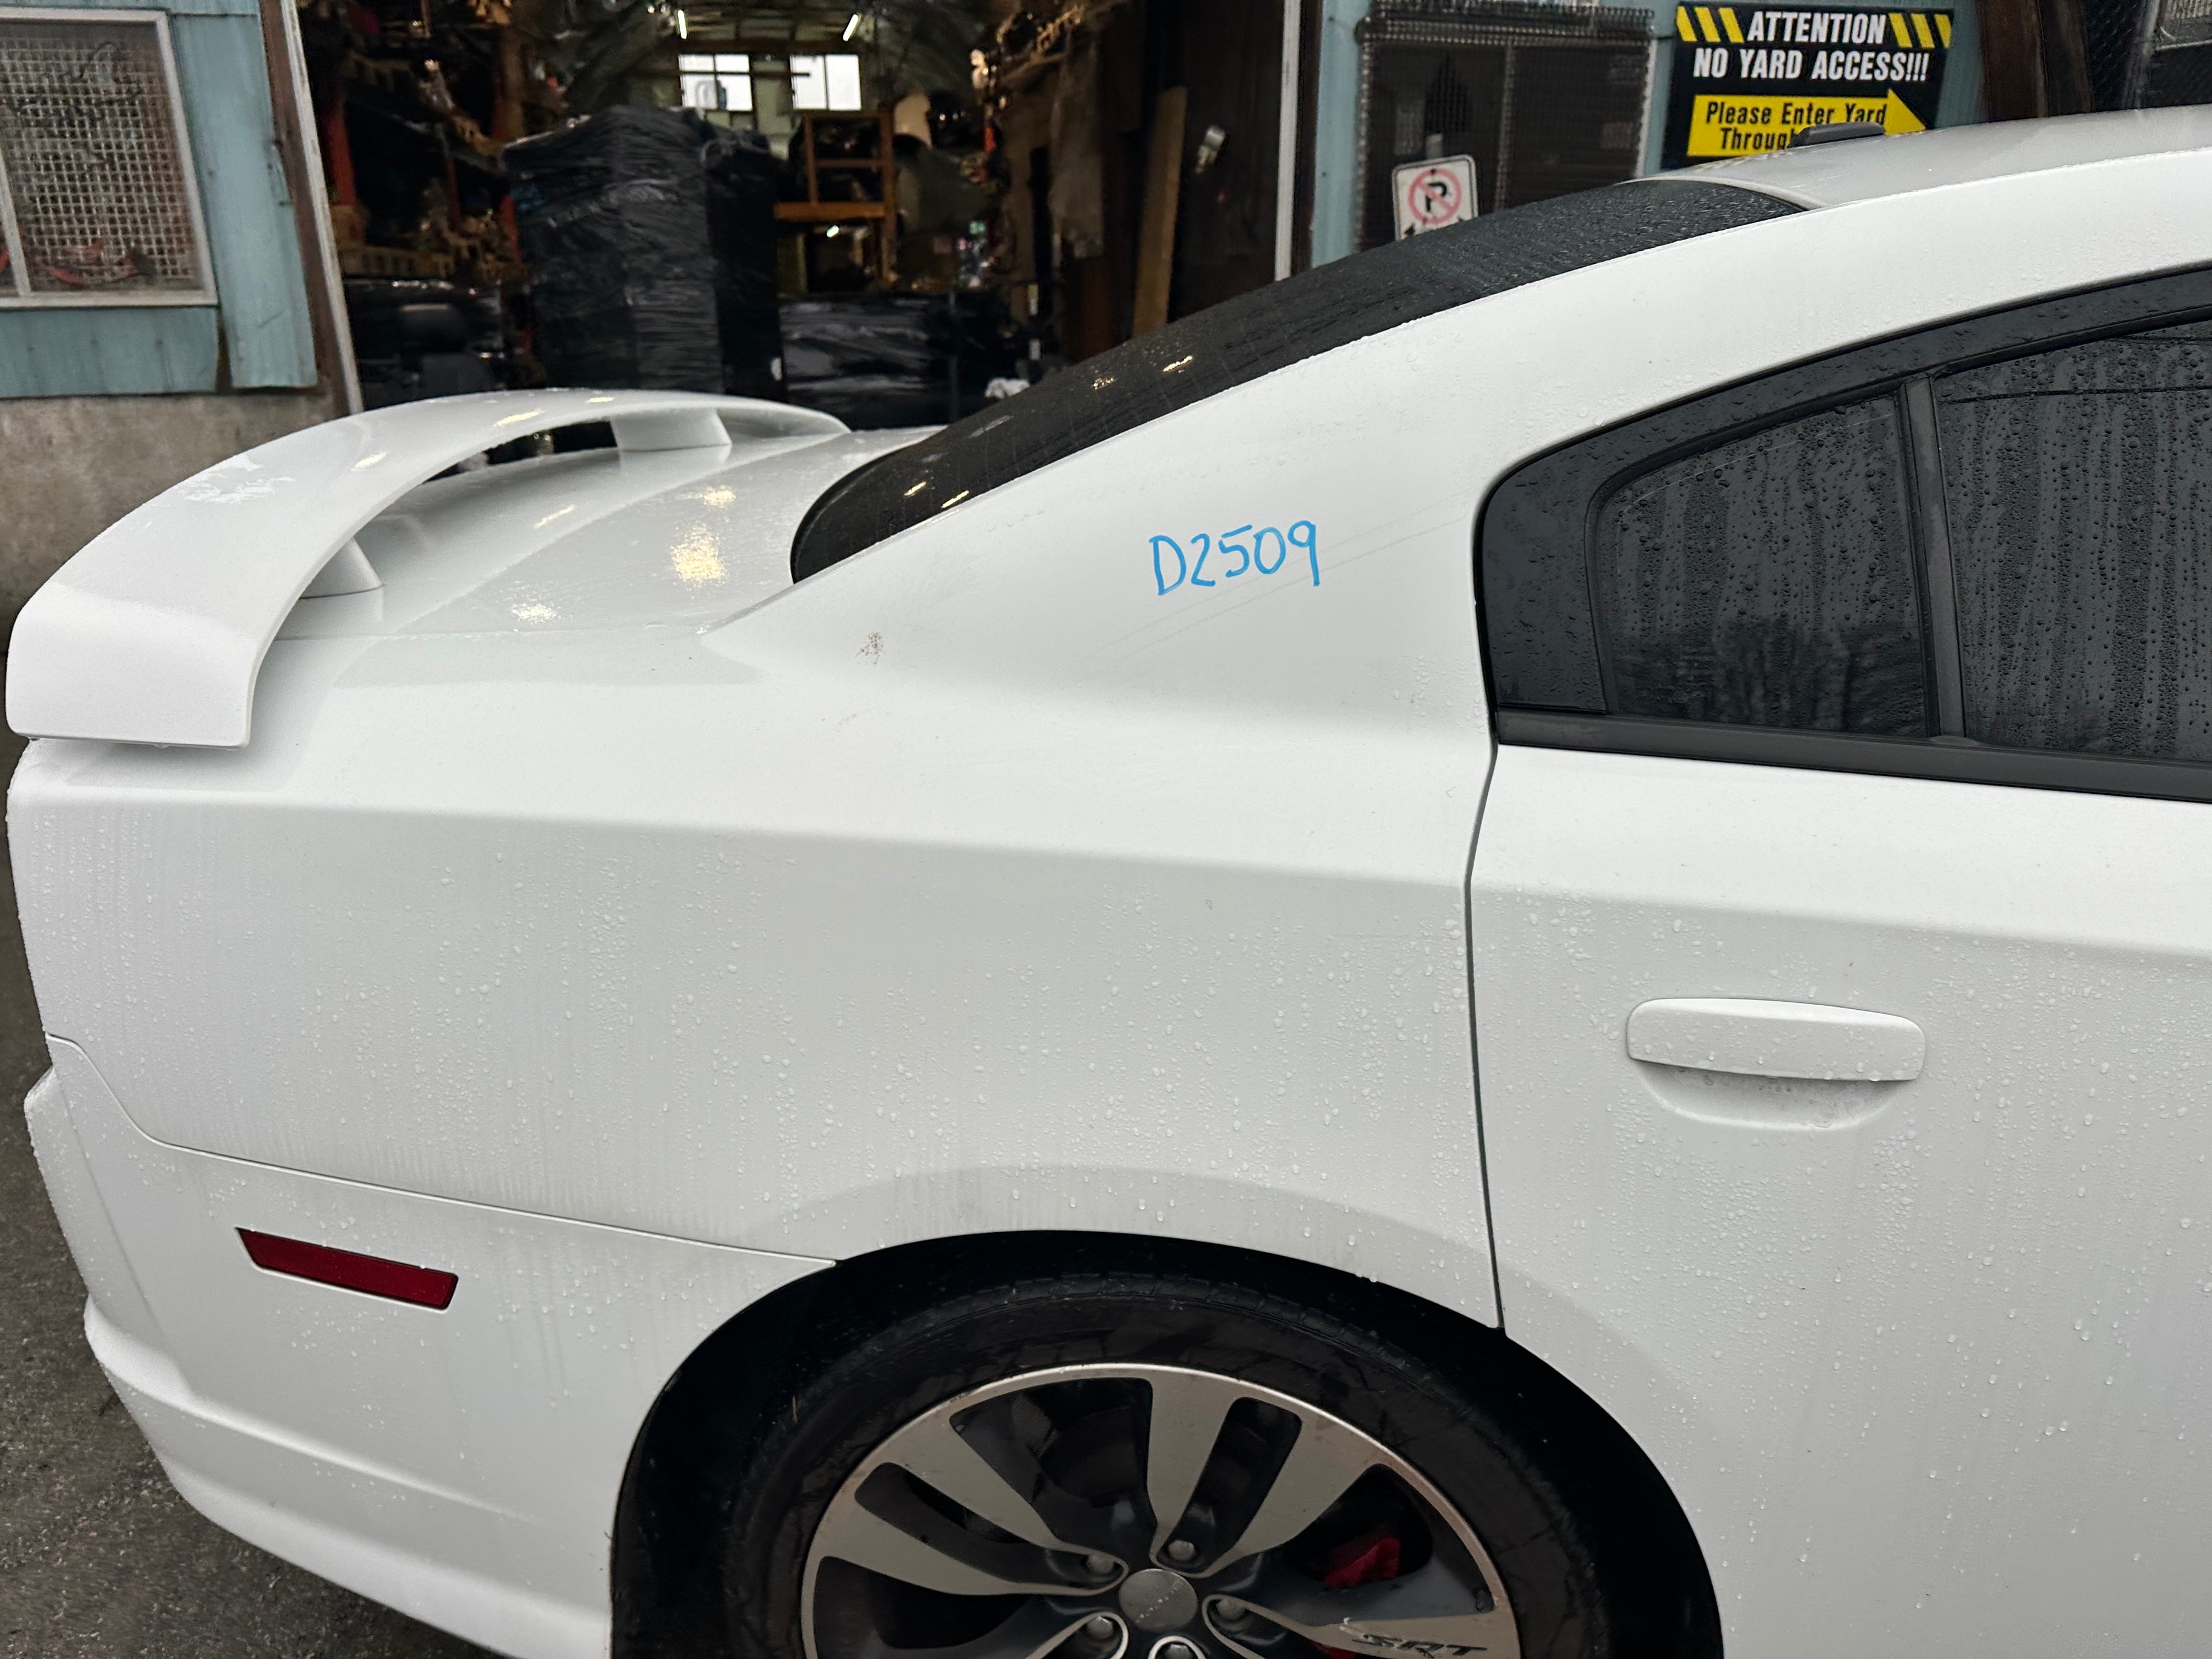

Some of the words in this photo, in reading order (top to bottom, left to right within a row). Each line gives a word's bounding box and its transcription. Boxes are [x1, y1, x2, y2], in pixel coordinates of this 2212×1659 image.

[1747, 11, 1887, 44] ATTENTION
[1693, 48, 1729, 78] NO
[1740, 50, 1803, 79] YARD
[1811, 52, 1929, 81] ACCESS!!!
[1706, 101, 1771, 124] Please
[1781, 103, 1835, 125] Enter
[1844, 103, 1887, 124] Yard
[1148, 520, 1320, 595] D2509
[1351, 1634, 1488, 1658] SRT
